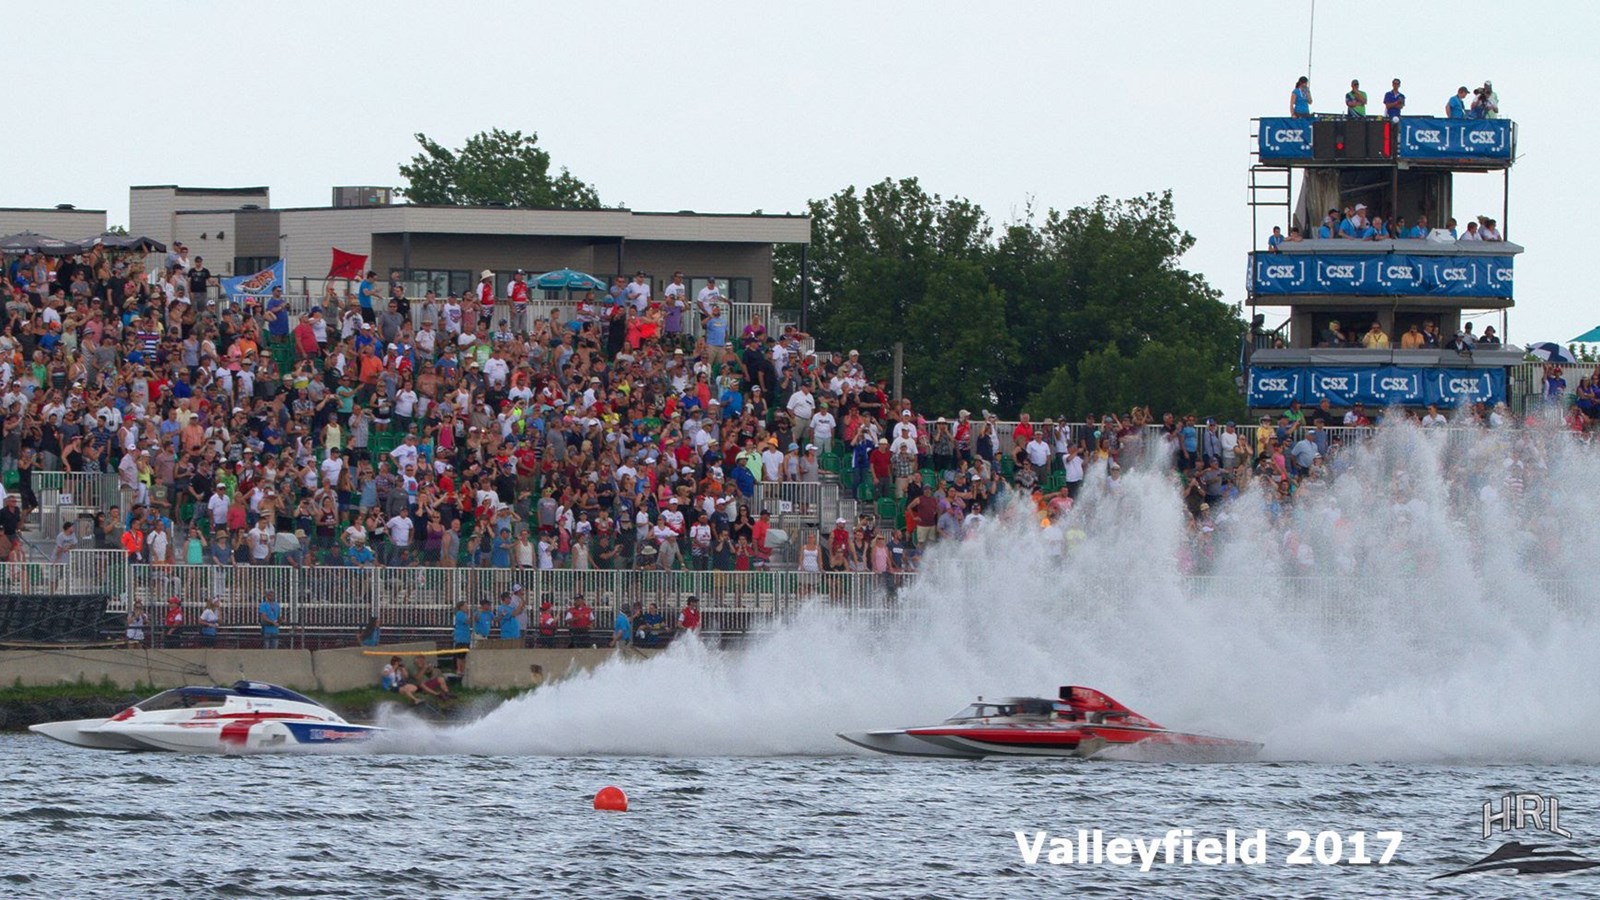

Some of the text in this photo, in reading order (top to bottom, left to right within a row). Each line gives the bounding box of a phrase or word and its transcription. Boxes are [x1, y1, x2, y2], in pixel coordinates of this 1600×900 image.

[1275, 129, 1304, 143] CSX
[1415, 130, 1441, 143] CSX
[1469, 131, 1496, 145] CSX
[1266, 265, 1295, 279] CSX
[1326, 265, 1355, 279] CSX
[1386, 266, 1413, 280] CSX
[1443, 268, 1467, 281] CSX
[1496, 268, 1513, 281] CS
[1258, 378, 1288, 392] CSX
[1320, 377, 1349, 391] CSX
[1380, 377, 1409, 391] CSX
[1450, 378, 1480, 394] CSX
